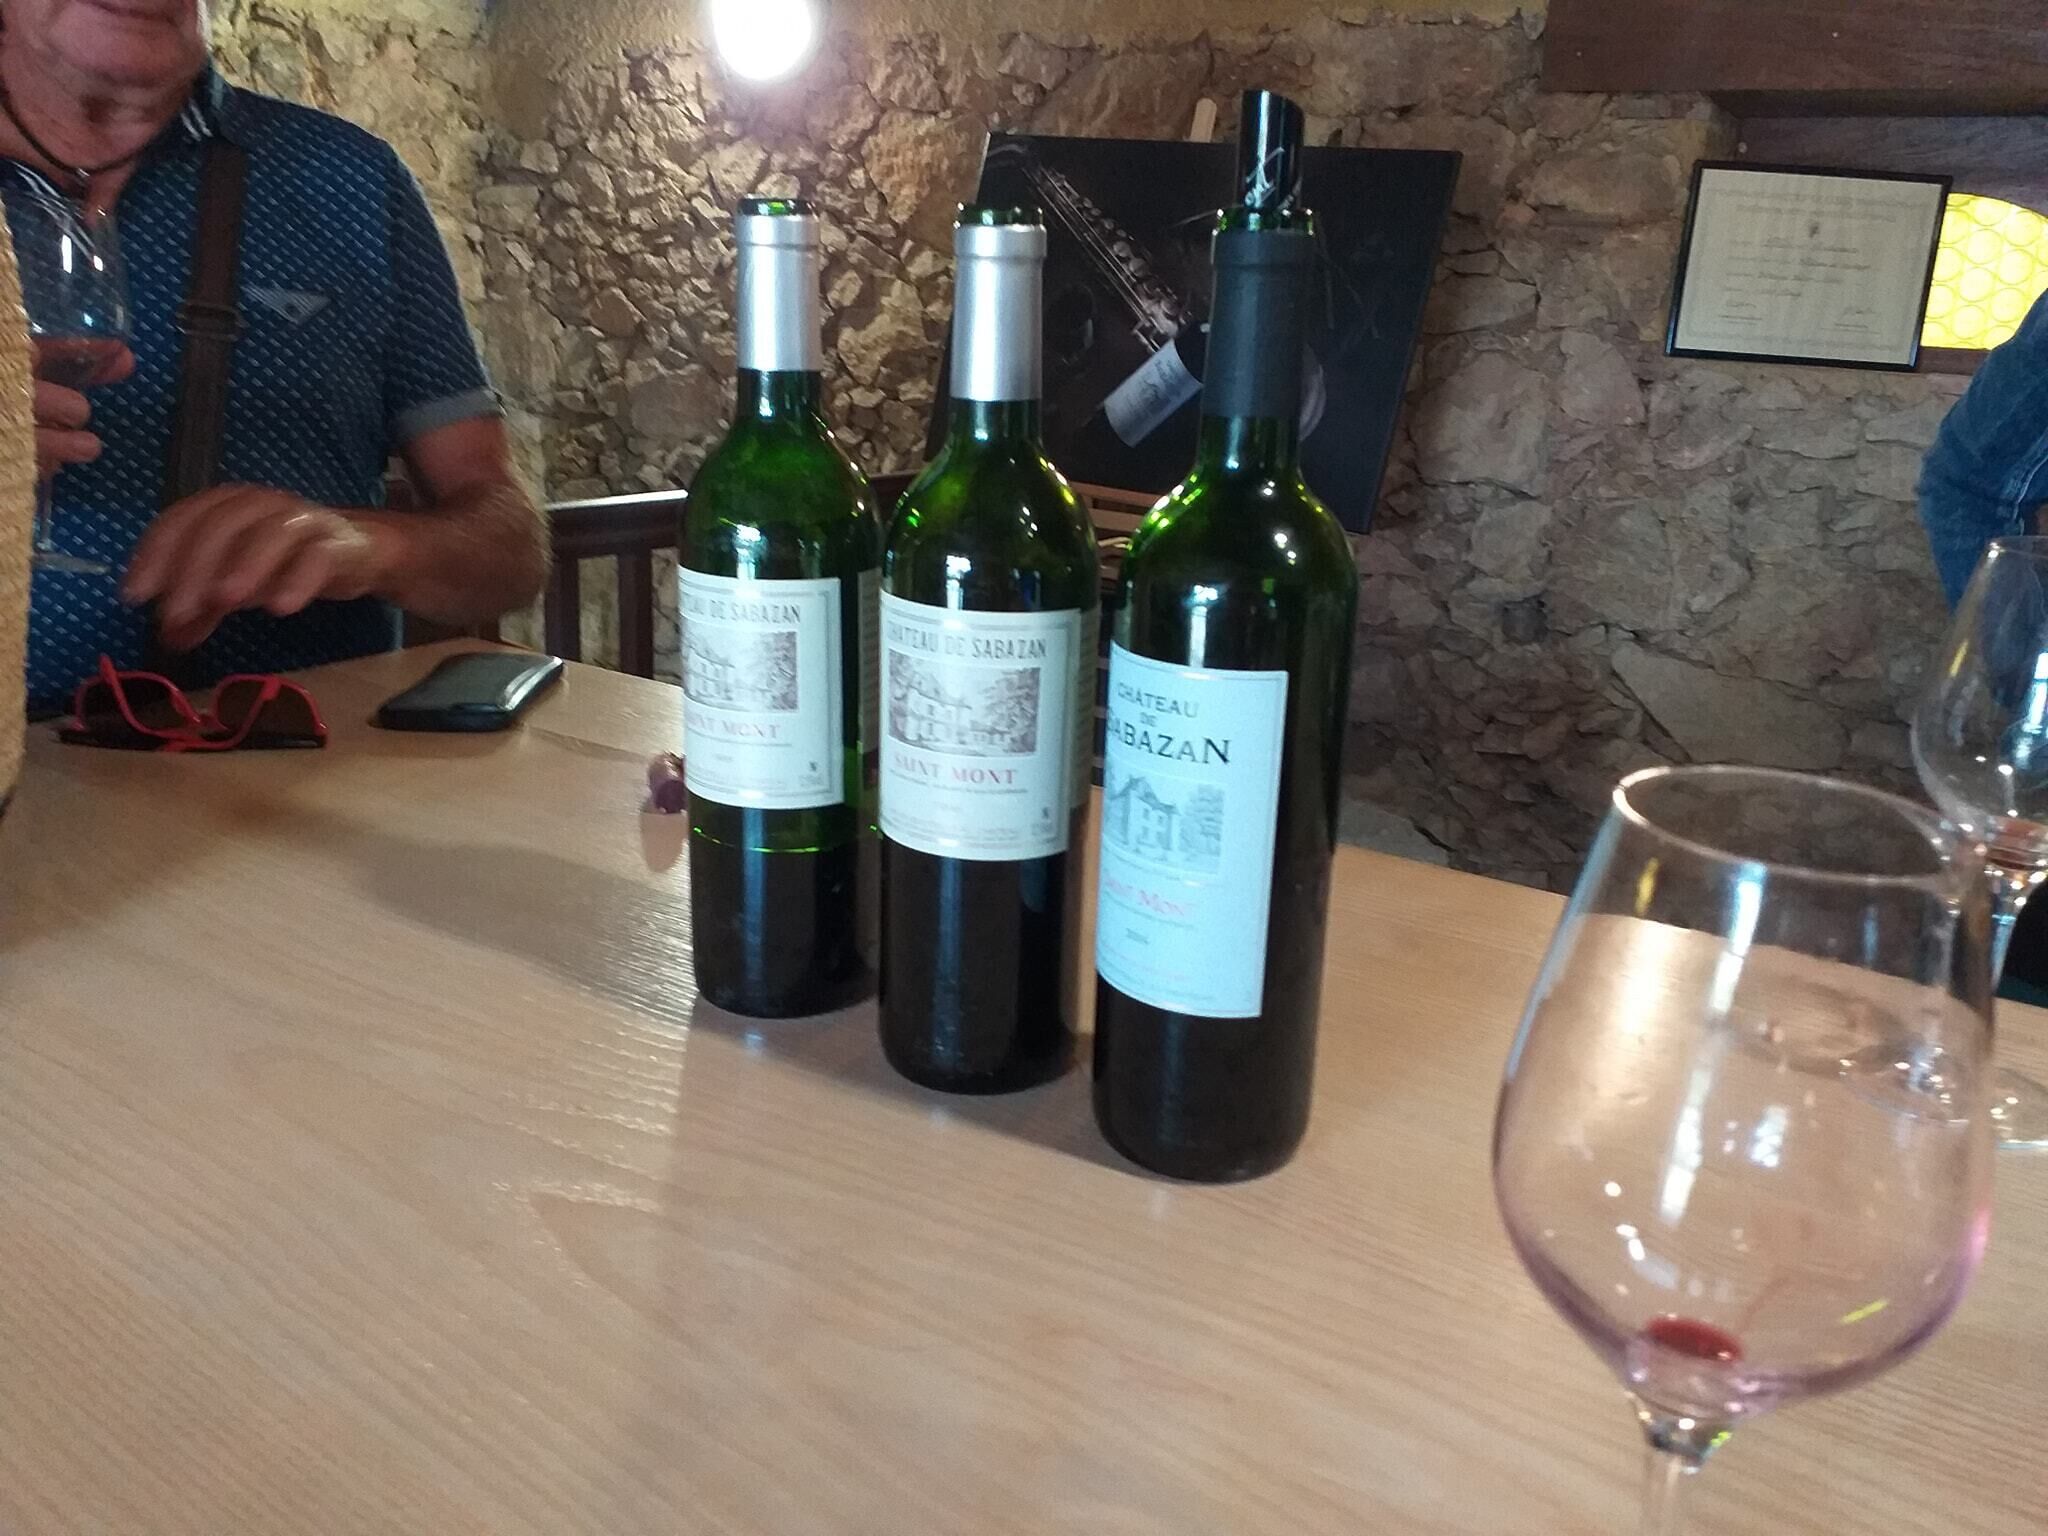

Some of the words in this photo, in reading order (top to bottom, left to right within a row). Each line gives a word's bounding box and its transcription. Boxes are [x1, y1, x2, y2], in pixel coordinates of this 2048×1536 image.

[730, 602, 800, 624] SABAZAN
[971, 637, 1049, 660] SABAZAN
[952, 765, 1019, 785] MONT
